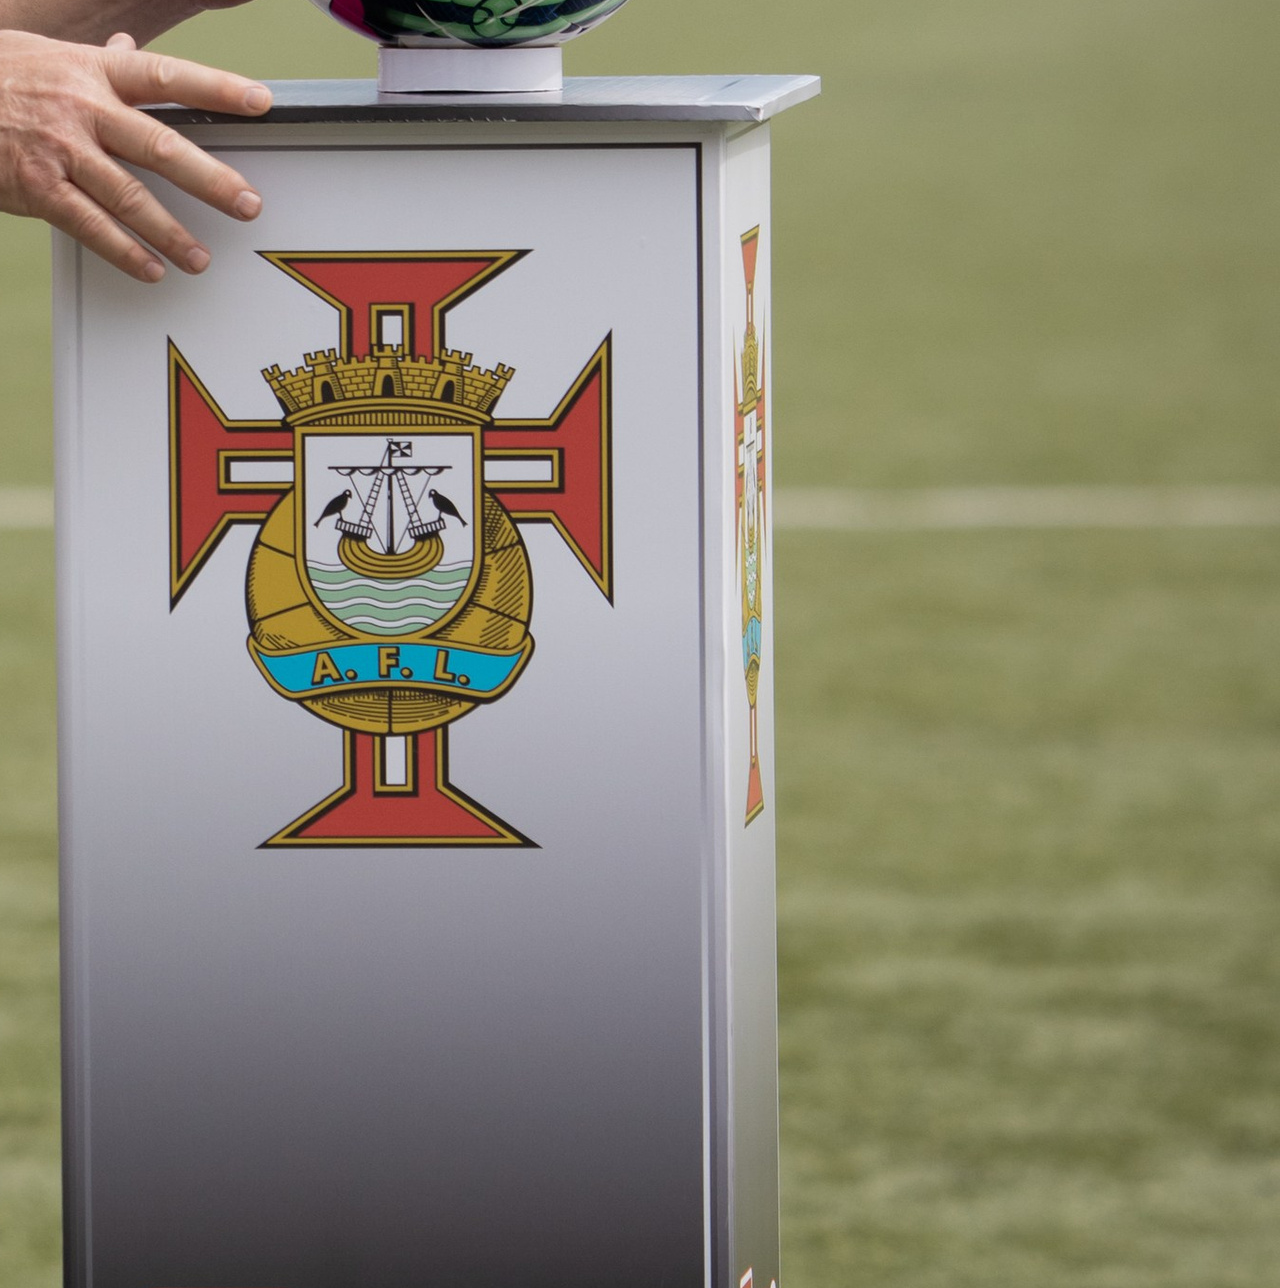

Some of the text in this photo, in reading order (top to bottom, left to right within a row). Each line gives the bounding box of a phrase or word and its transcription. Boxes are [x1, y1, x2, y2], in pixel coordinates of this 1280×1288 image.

[311, 646, 470, 686] A. F. L.
